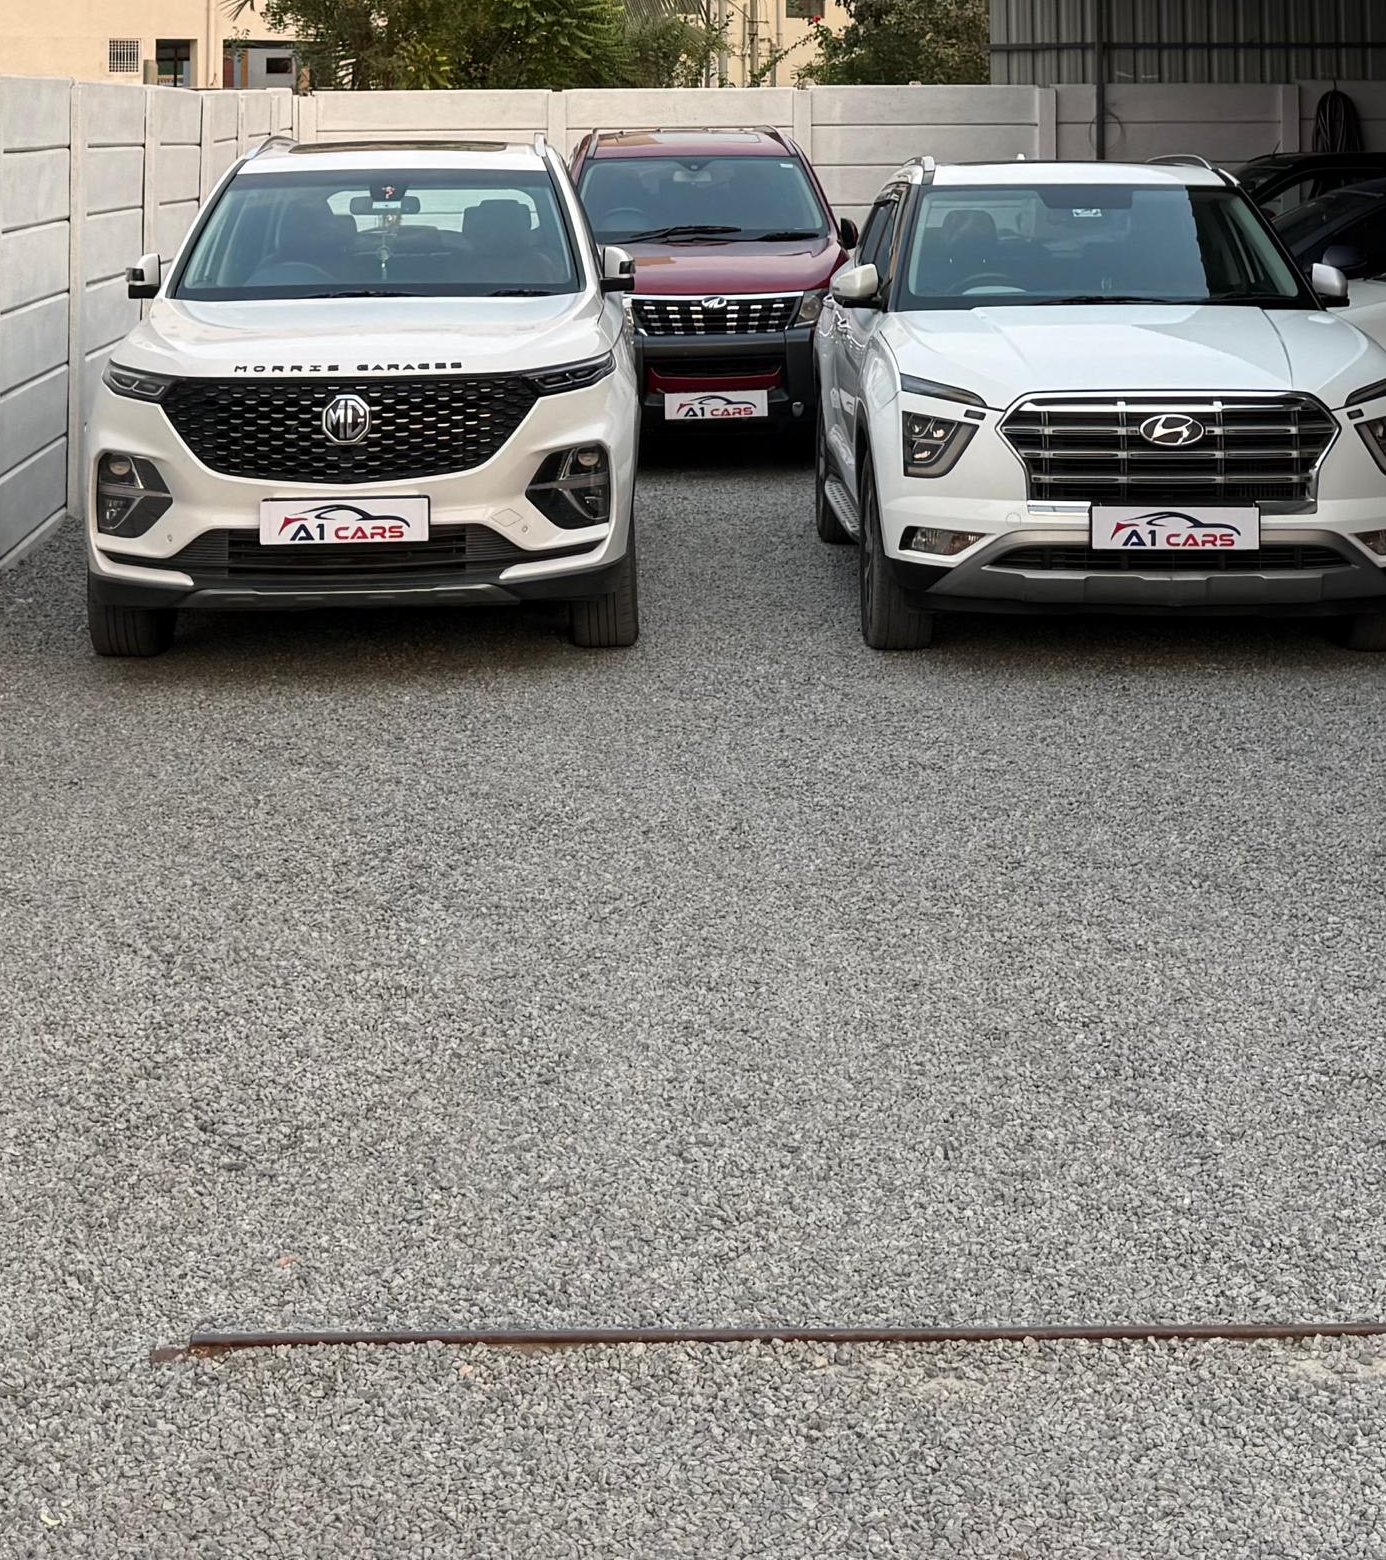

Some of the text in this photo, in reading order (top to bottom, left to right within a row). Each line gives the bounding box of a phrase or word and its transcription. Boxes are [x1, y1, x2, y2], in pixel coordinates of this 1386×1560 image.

[234, 362, 463, 373] MORRIS GARAGES
[326, 397, 367, 440] MG
[684, 407, 754, 417] A1 CARS
[290, 523, 405, 541] A1 CARS
[1122, 529, 1235, 547] A1 CARS
